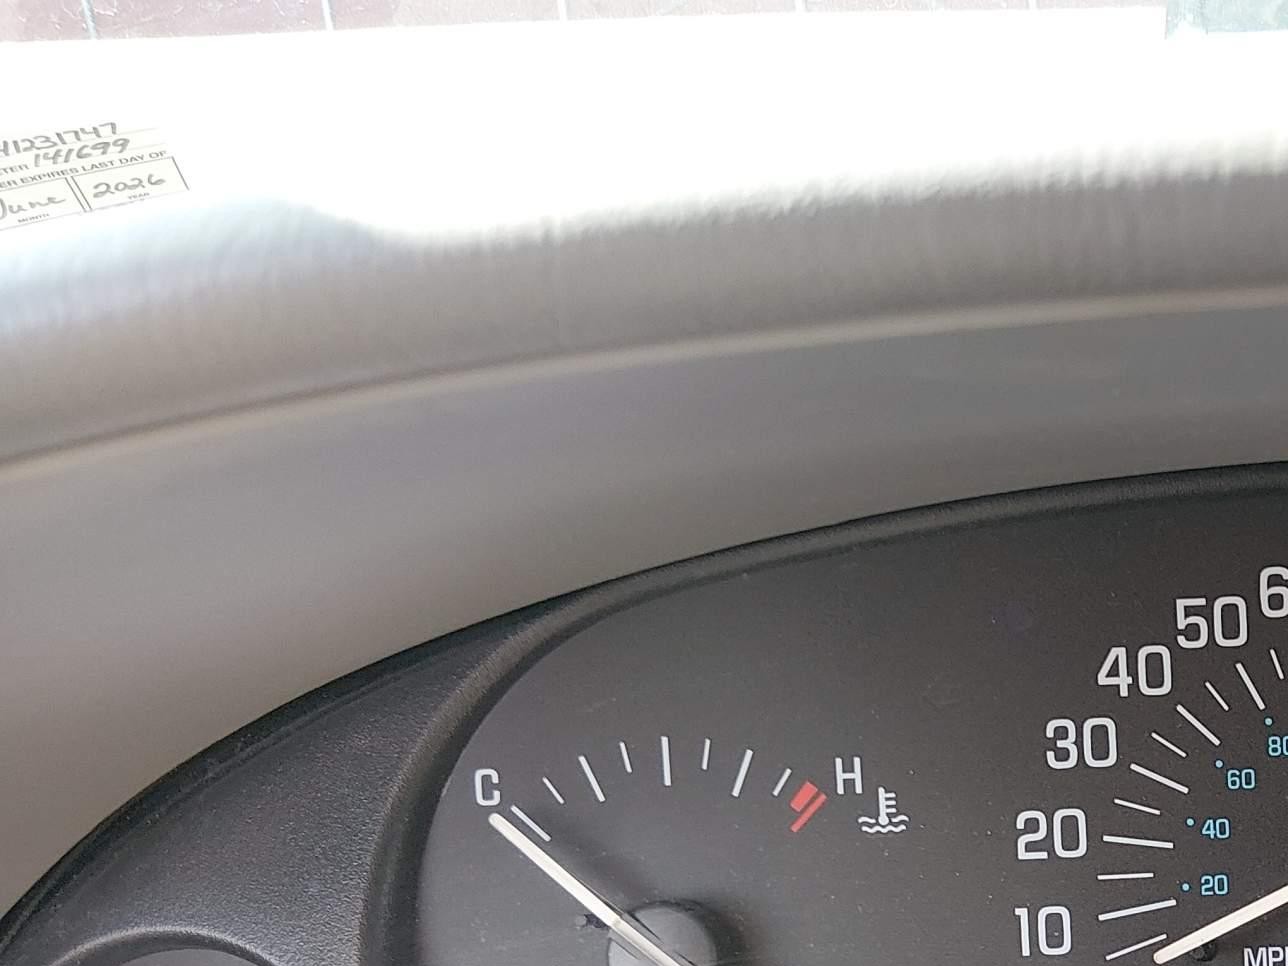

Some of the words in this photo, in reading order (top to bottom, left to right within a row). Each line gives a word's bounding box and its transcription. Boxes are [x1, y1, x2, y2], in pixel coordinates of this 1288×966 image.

[20, 166, 80, 185] EXPIRES
[81, 160, 116, 172] LAST
[118, 153, 145, 165] DAY
[148, 149, 168, 159] OF
[33, 137, 131, 168] 141699
[93, 172, 166, 199] 2026
[1175, 596, 1248, 649] 50
[1097, 645, 1172, 697] 40
[1045, 717, 1118, 770] 30
[474, 768, 501, 806] C
[834, 756, 863, 795] H
[1227, 768, 1256, 790] 60
[1016, 808, 1087, 860] 20
[1201, 818, 1230, 839] 40
[1200, 874, 1228, 896] 20
[1014, 905, 1072, 957] 10
